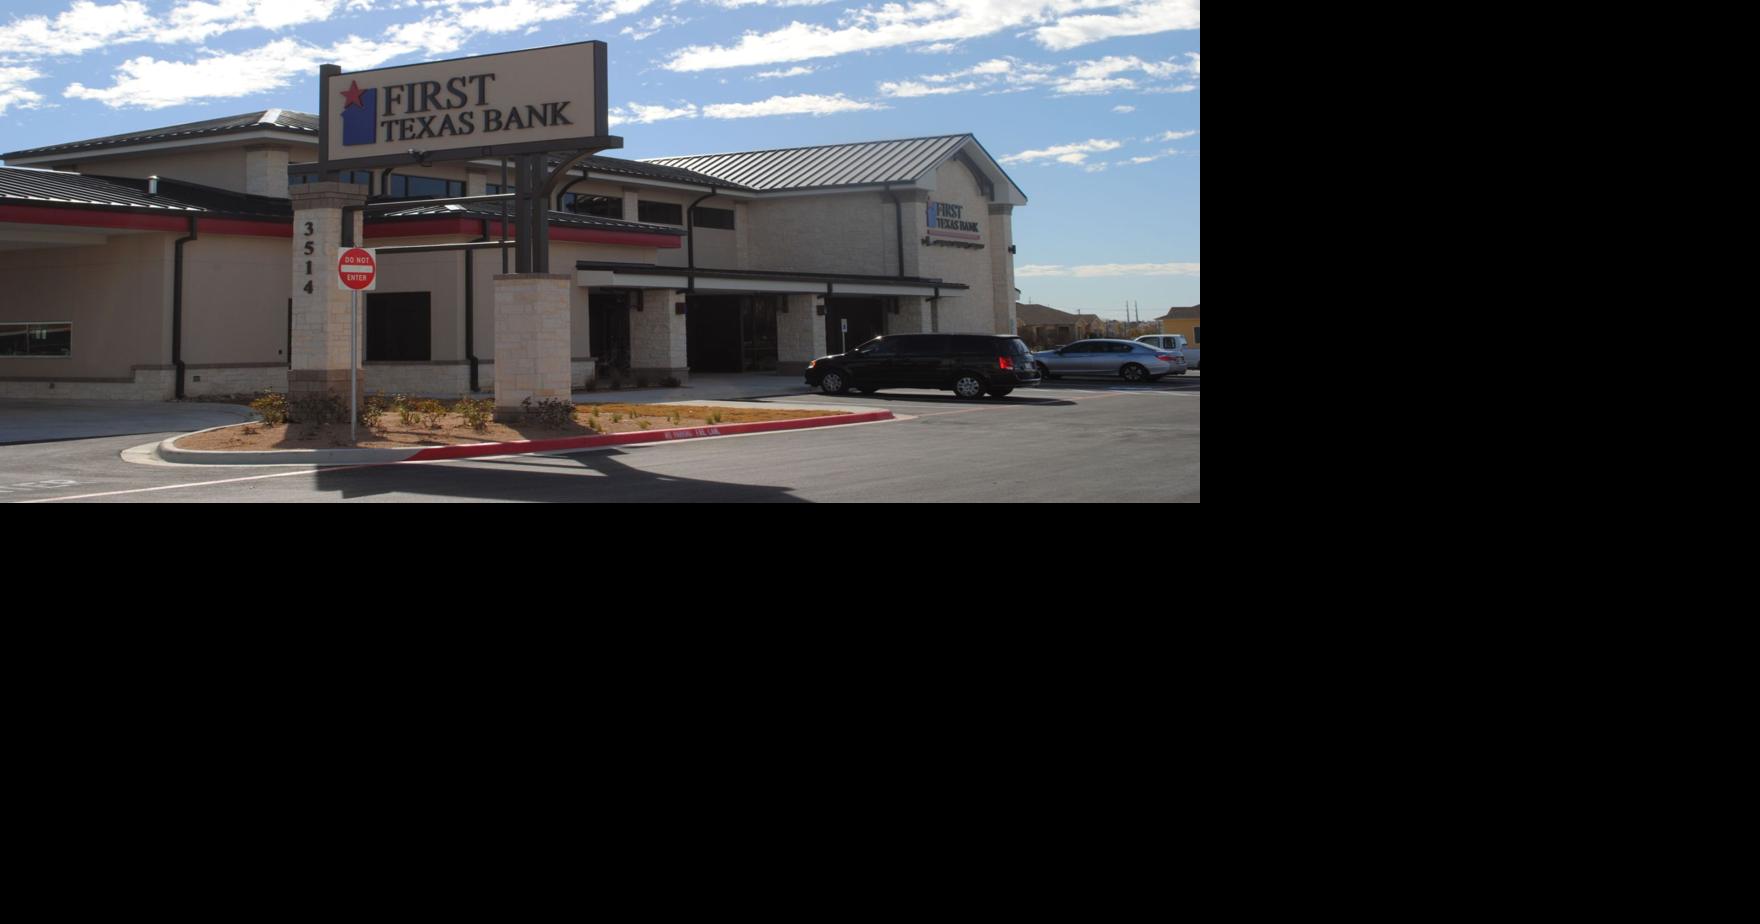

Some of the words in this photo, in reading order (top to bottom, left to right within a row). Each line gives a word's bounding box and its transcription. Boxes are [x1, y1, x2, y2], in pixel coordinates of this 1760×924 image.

[382, 73, 496, 116] FIRST
[381, 110, 475, 143] TEXAS
[482, 101, 574, 133] BANK
[936, 202, 963, 219] FIRST
[937, 218, 959, 230] TEXAS
[959, 221, 979, 232] BANK
[303, 221, 314, 294] 3514
[345, 256, 355, 264] DO
[356, 256, 369, 264] NOT
